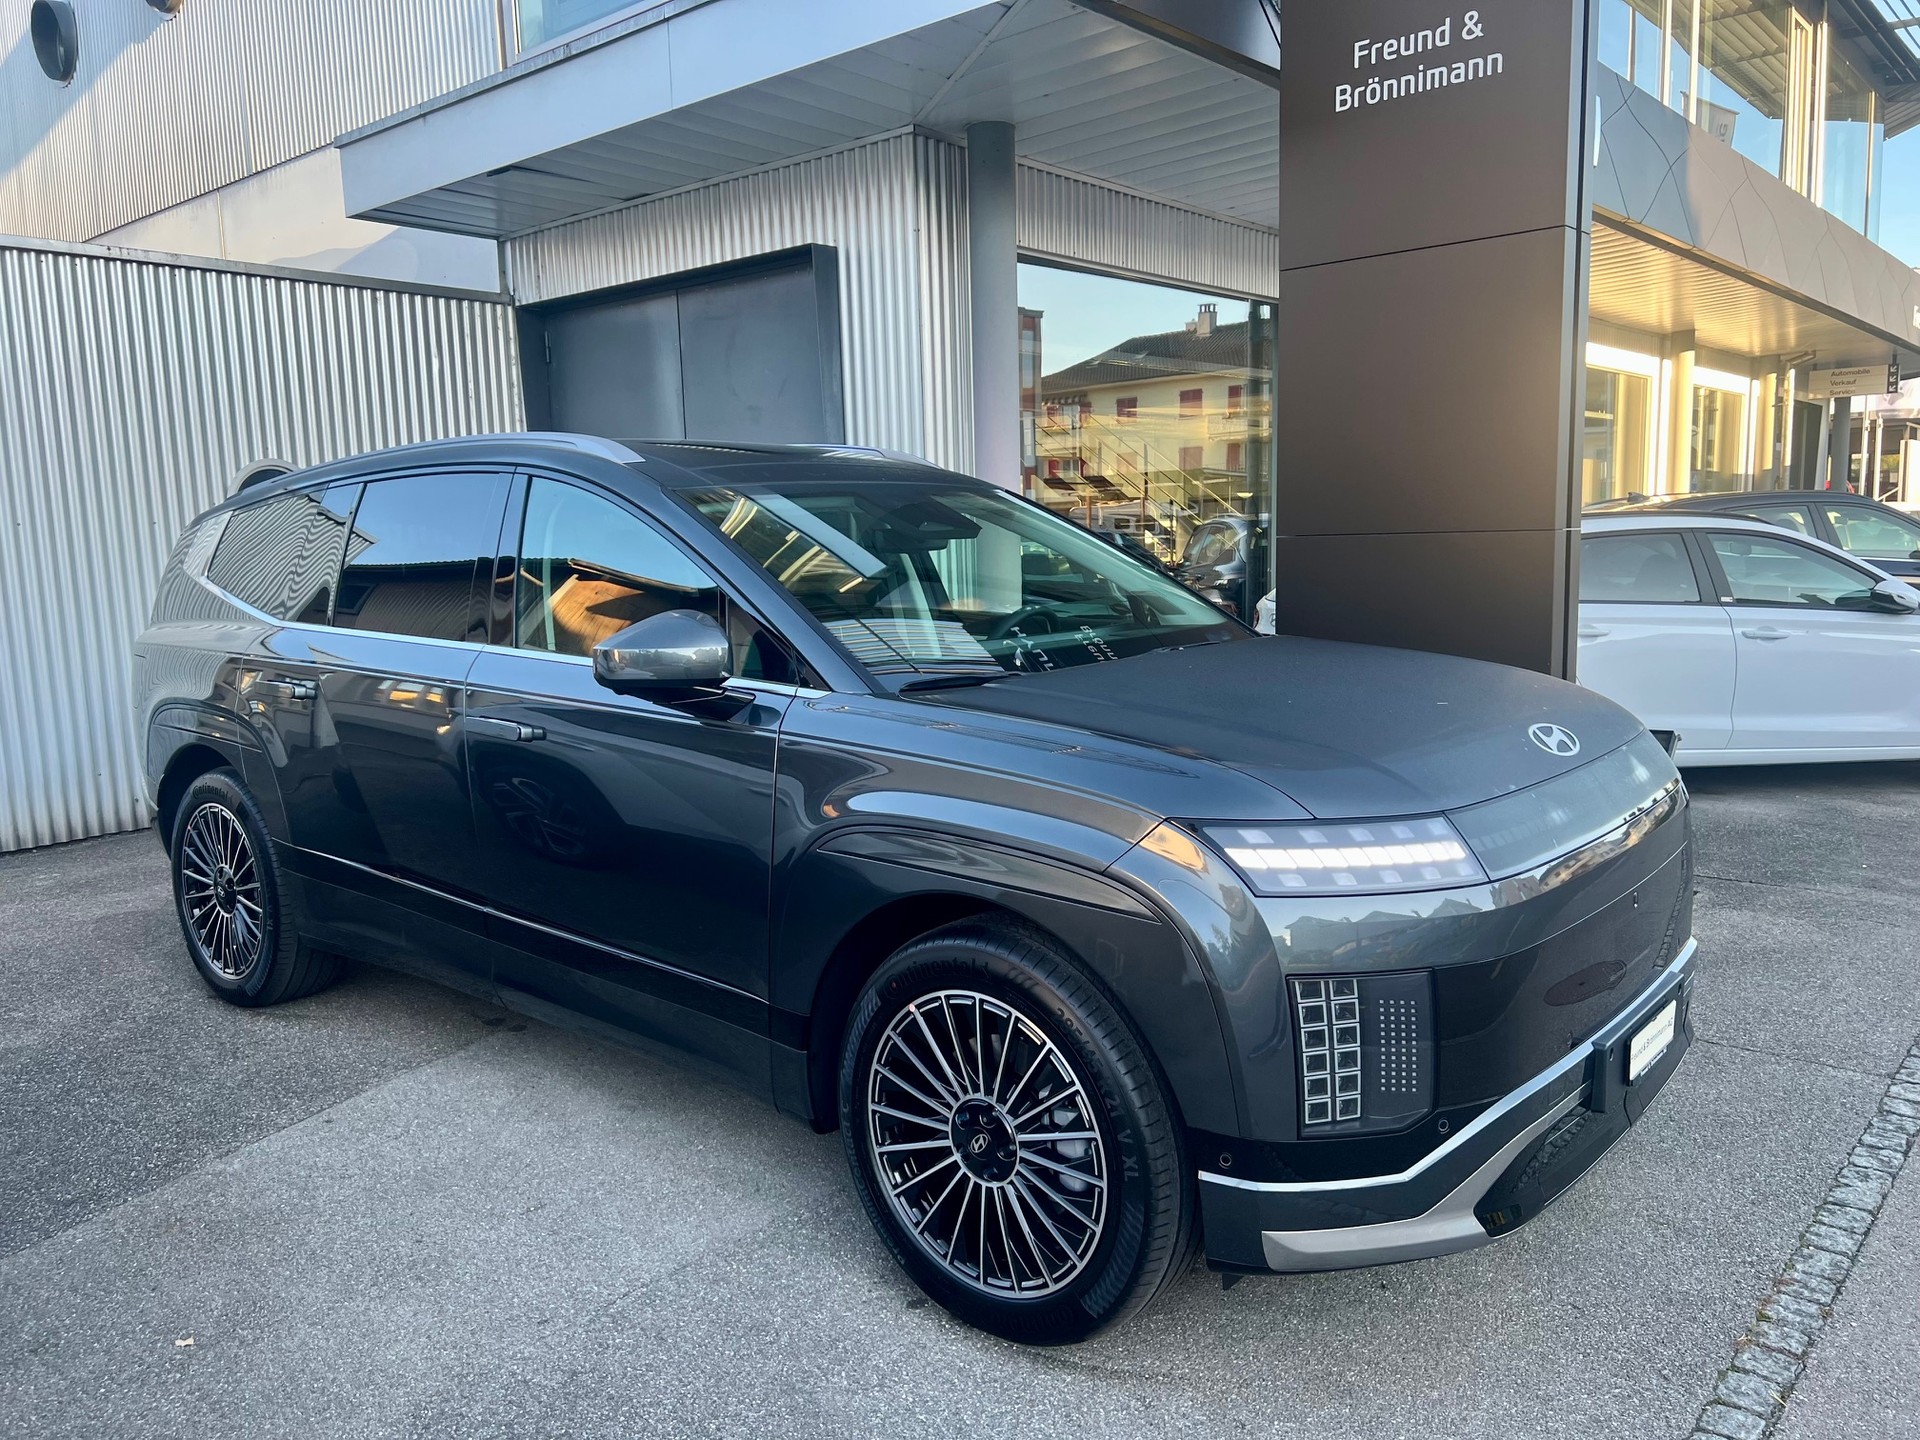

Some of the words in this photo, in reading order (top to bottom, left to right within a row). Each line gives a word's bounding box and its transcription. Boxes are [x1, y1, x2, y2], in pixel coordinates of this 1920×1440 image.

[1353, 17, 1451, 69] Freund
[1461, 10, 1485, 41] &
[1335, 52, 1503, 112] Brönnimann
[1830, 368, 1871, 377] Automobile
[192, 782, 228, 800] Continental
[1120, 1153, 1140, 1186] XL
